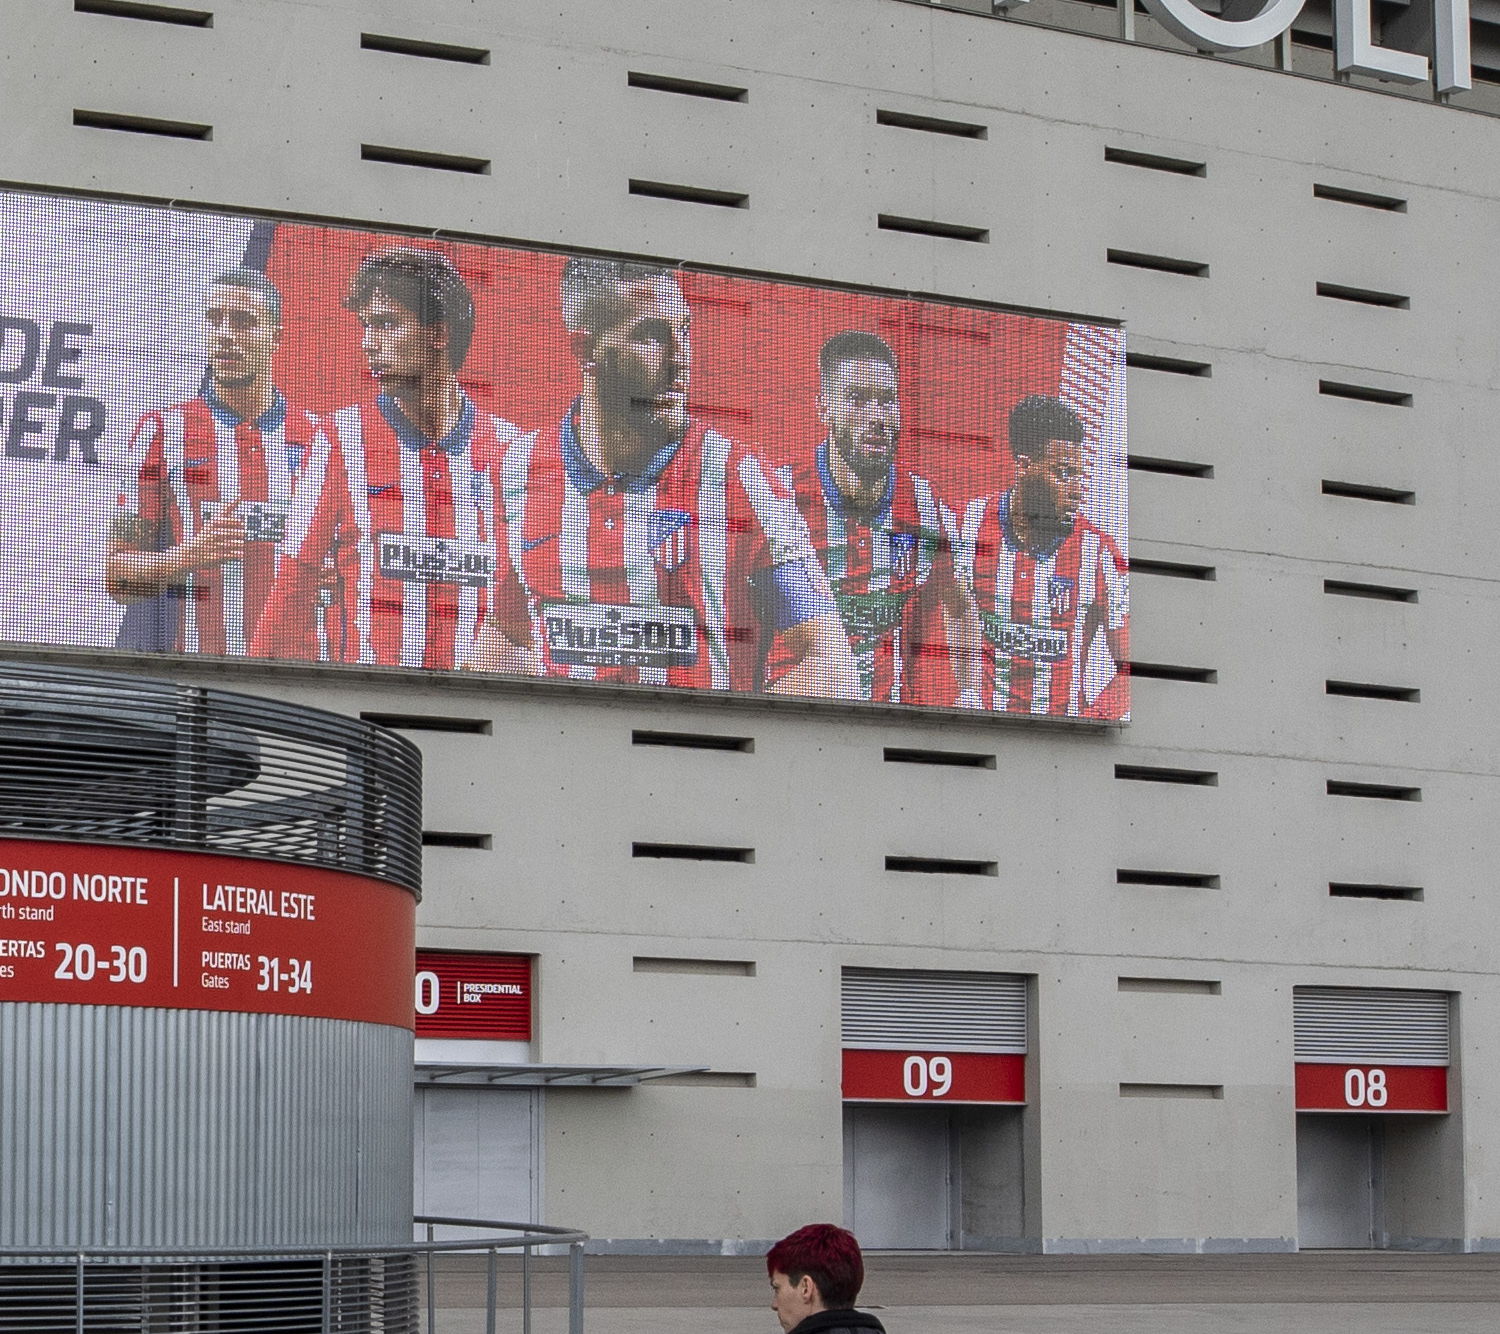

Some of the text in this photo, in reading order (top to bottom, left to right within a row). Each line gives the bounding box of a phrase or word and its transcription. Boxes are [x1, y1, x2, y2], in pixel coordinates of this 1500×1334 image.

[545, 616, 693, 650] Plus500
[72, 873, 149, 906] NORTE
[202, 883, 316, 921] LATERAL ESTE
[18, 904, 55, 922] stand
[201, 916, 251, 936] East stand
[53, 941, 149, 984] 20-30
[201, 950, 314, 995] PUERTAS 31-34
[201, 972, 230, 990] Gates
[463, 983, 524, 995] PRESIDENTIAL
[463, 993, 482, 1004] BOX
[903, 1054, 953, 1097] 09
[1343, 1068, 1389, 1108] 08
